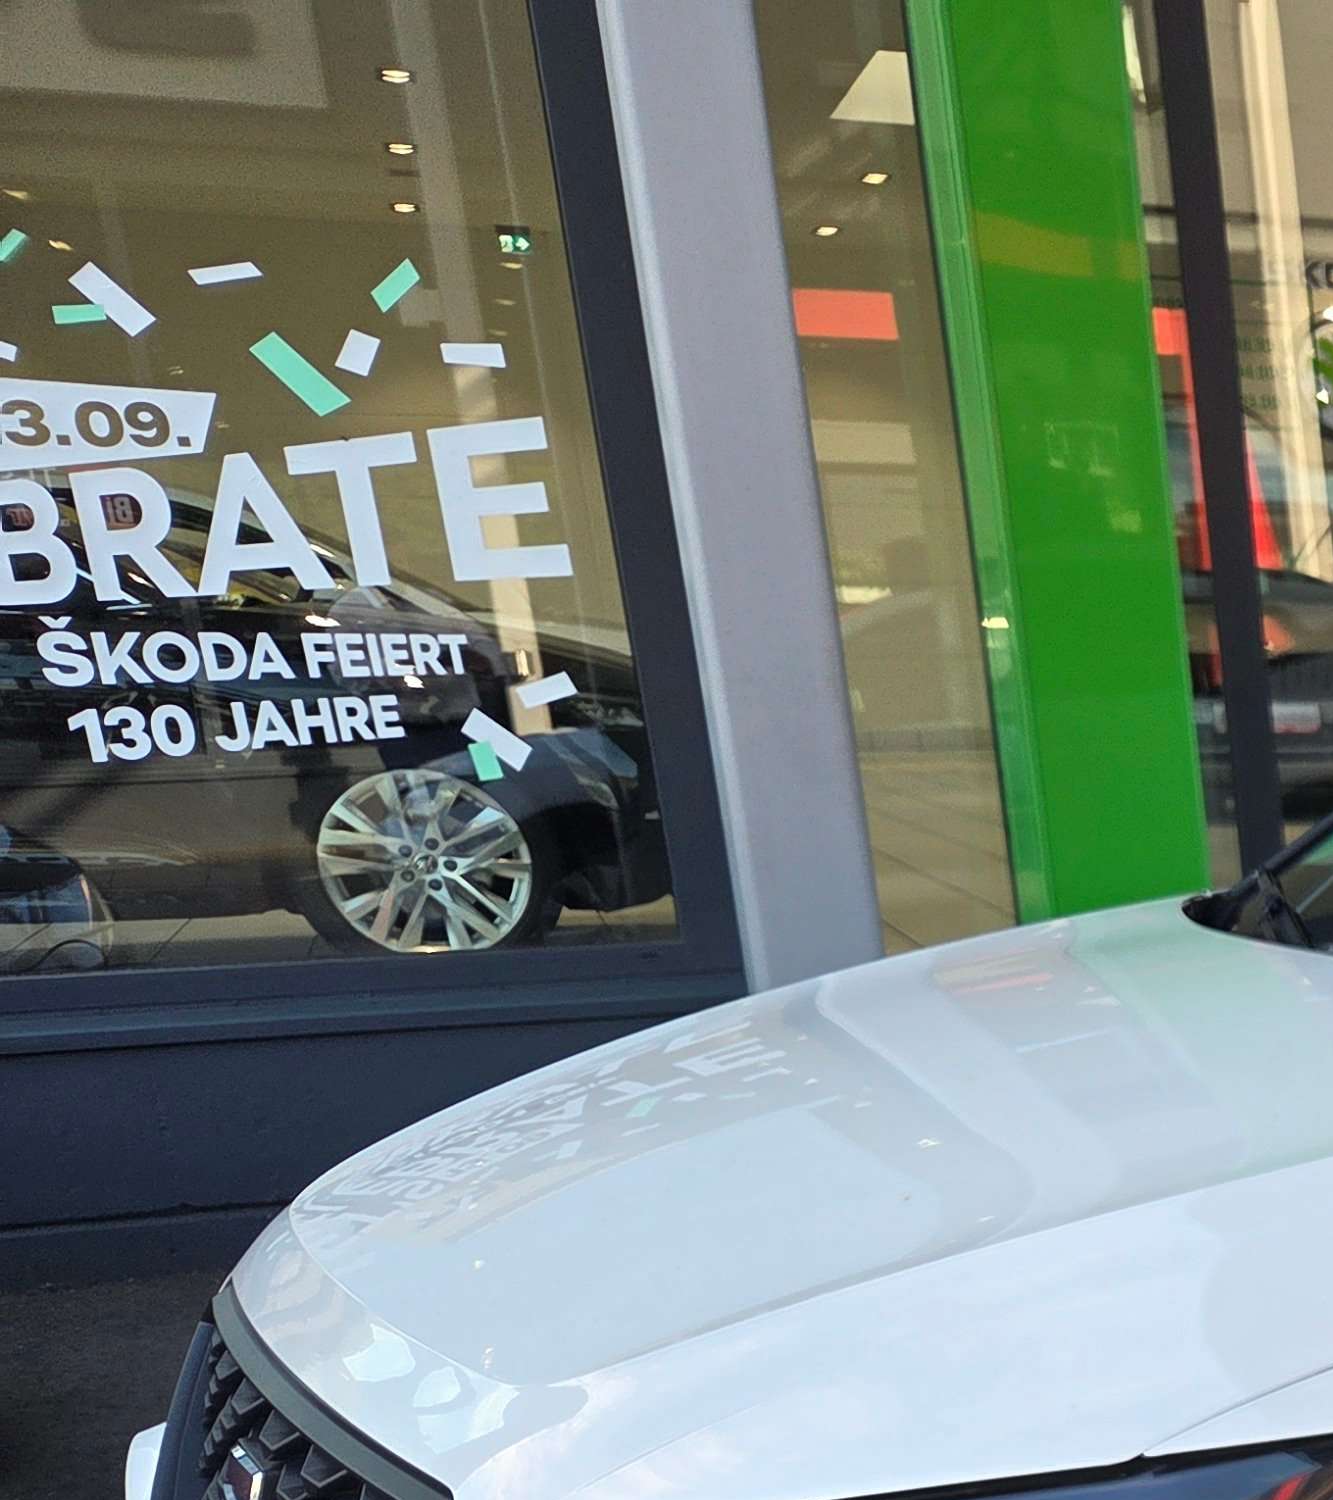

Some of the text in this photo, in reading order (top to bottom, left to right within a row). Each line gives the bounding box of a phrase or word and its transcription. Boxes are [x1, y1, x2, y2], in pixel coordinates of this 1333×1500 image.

[0, 399, 192, 447] 3.09.
[36, 616, 469, 687] ŠKODA FEIERT
[67, 694, 406, 763] 130 JAHRE
